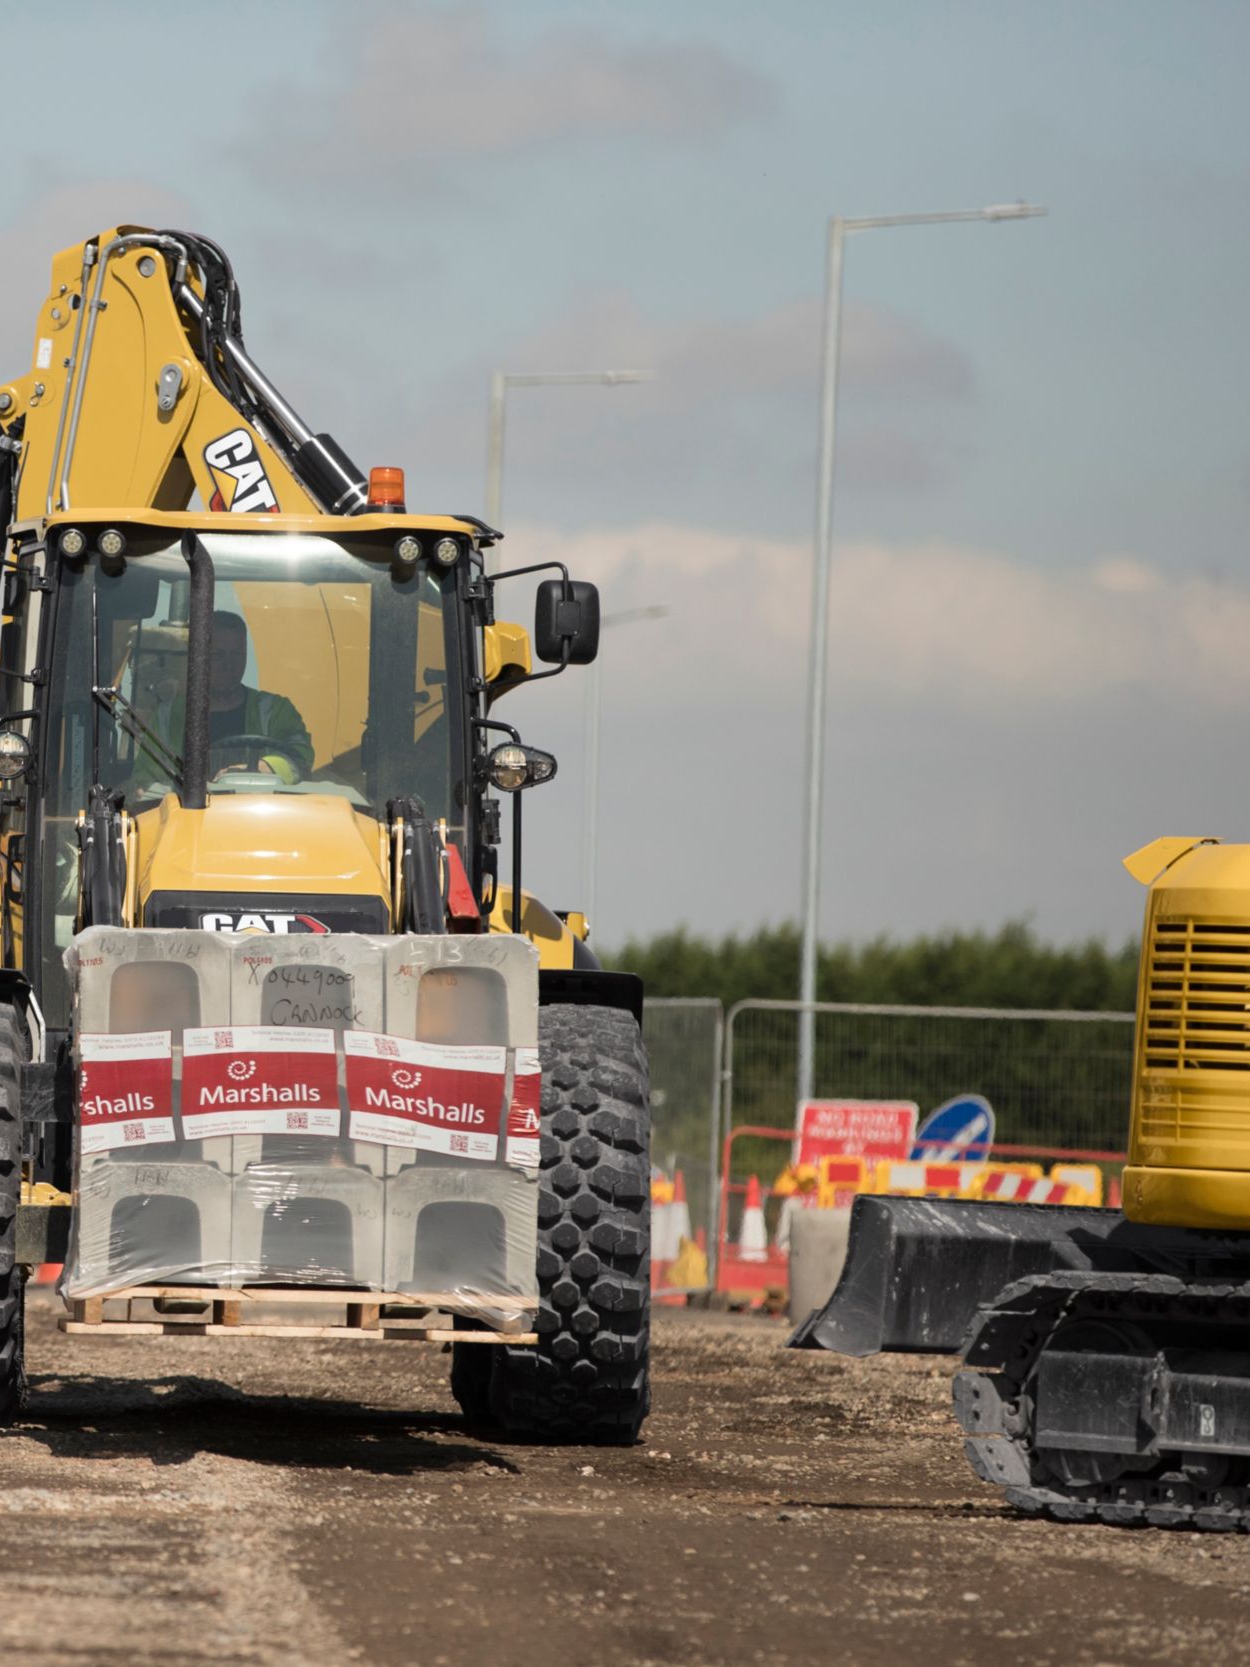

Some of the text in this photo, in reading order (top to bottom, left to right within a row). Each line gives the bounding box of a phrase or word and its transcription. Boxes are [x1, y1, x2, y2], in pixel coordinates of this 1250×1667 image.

[205, 429, 276, 512] CAT
[202, 914, 296, 935] CAT
[271, 998, 365, 1026] CANNOCK
[200, 1083, 321, 1106] Marshalls
[365, 1086, 485, 1124] Marshalls
